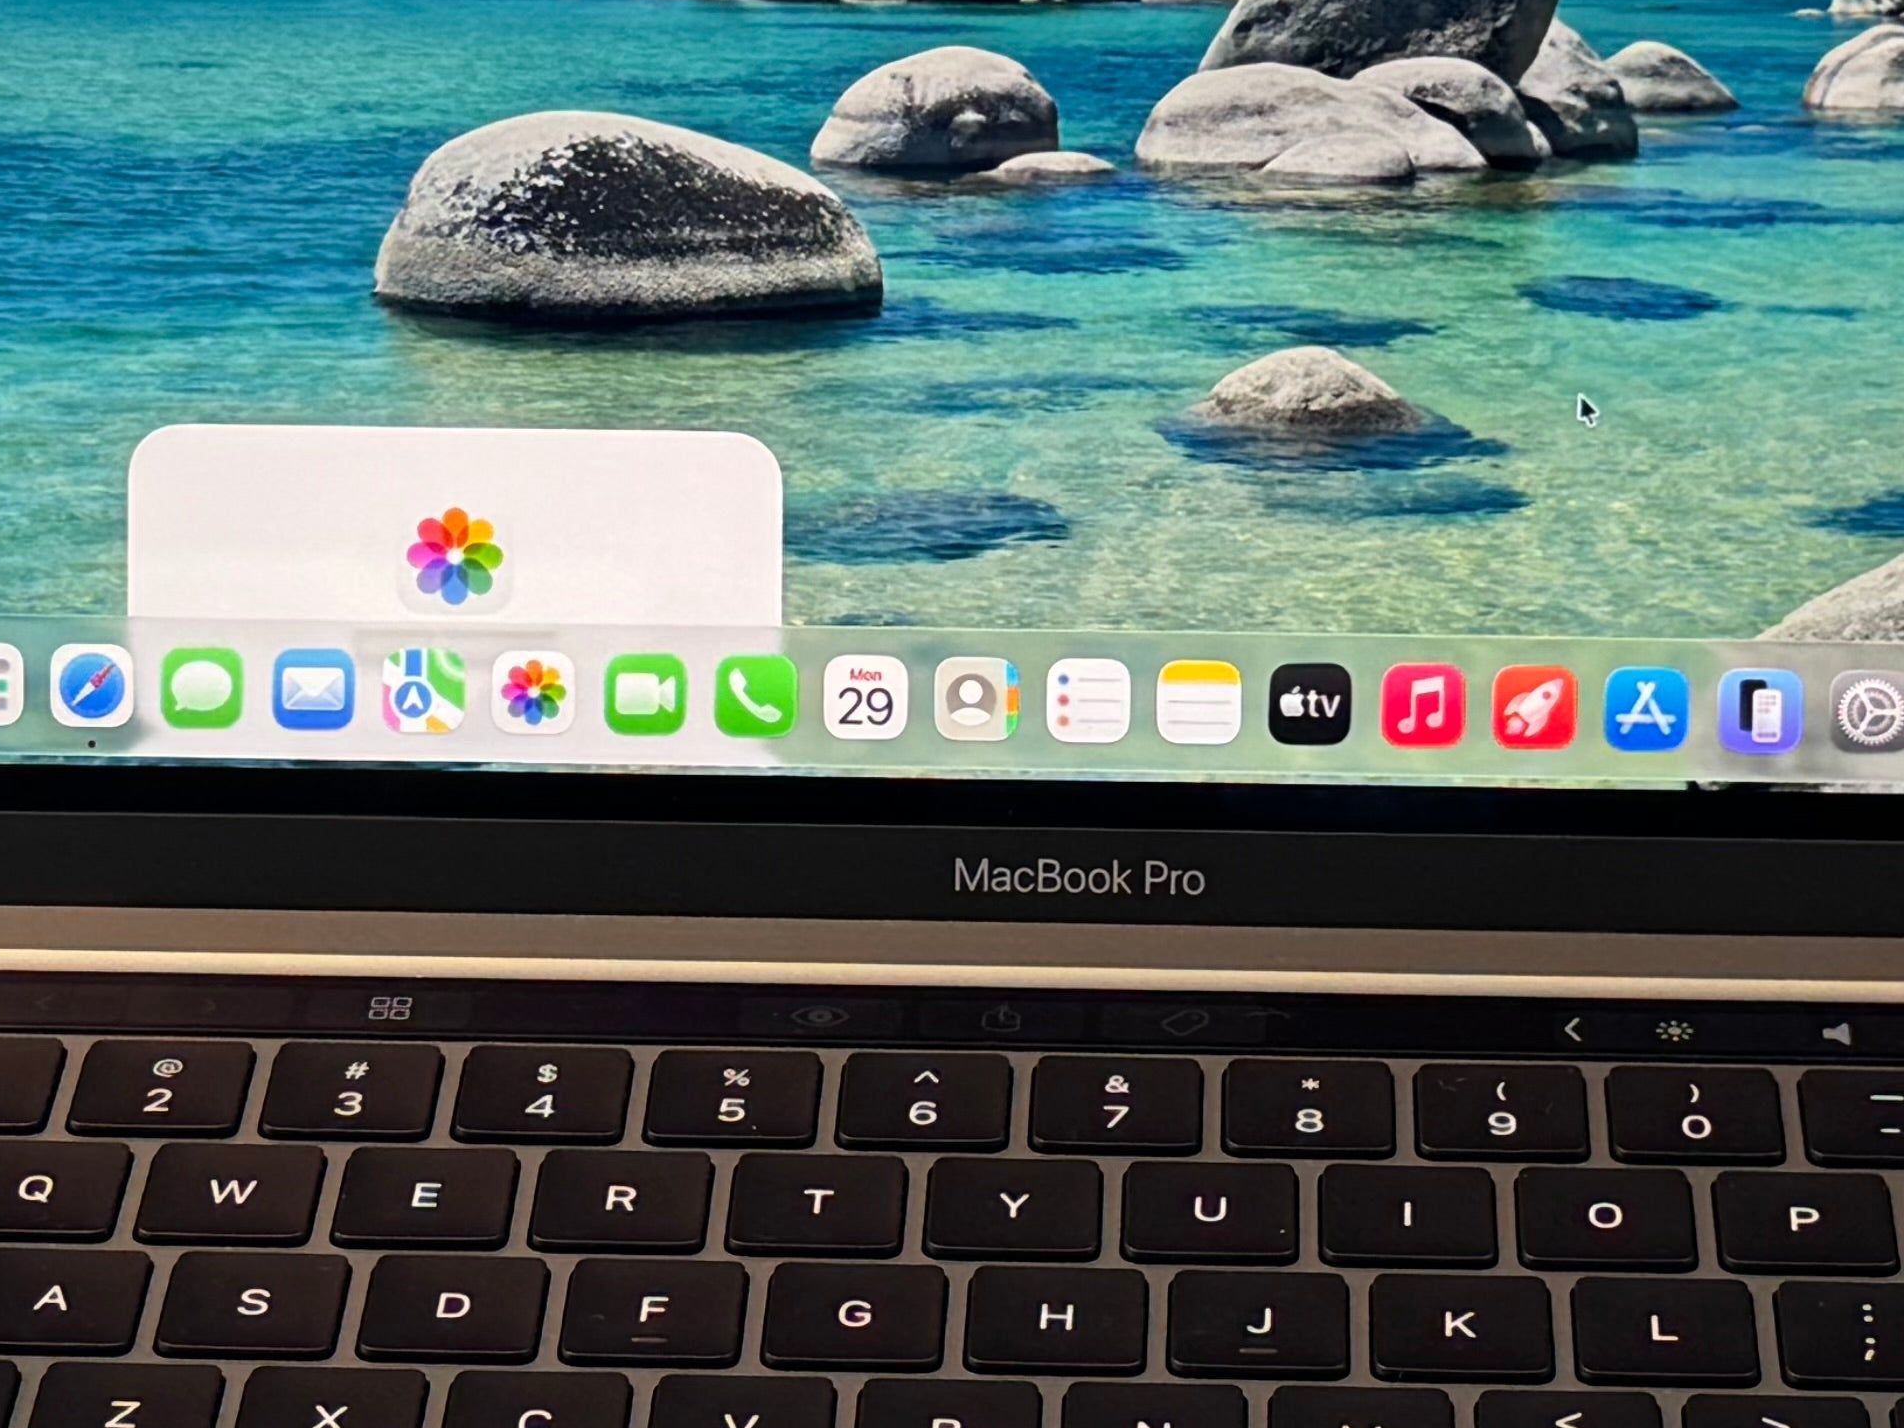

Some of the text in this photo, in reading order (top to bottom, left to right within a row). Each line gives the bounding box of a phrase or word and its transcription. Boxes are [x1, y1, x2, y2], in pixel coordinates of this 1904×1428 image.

[849, 666, 883, 683] Mon
[838, 686, 894, 726] 29
[1306, 691, 1341, 719] tv
[954, 857, 1206, 896] MacBook Pro
[152, 1058, 183, 1078] @
[345, 1061, 370, 1080] #
[537, 1063, 558, 1083] $
[723, 1068, 750, 1087] %
[1104, 1075, 1129, 1094] &
[143, 1088, 173, 1112] 2
[333, 1091, 363, 1116] 3
[524, 1094, 555, 1118] 4
[718, 1098, 746, 1122] 5
[908, 1101, 938, 1126] 6
[1103, 1105, 1130, 1129] 7
[1295, 1108, 1324, 1133] 8
[1487, 1111, 1517, 1136] 9
[18, 1174, 54, 1203] Q
[210, 1179, 258, 1205] W
[411, 1182, 442, 1208] E
[605, 1185, 637, 1212] R
[803, 1188, 835, 1215] T
[999, 1192, 1030, 1219] Y
[1194, 1196, 1227, 1222] U
[1403, 1201, 1412, 1227] I
[1588, 1202, 1623, 1229] O
[1789, 1206, 1820, 1232] P
[33, 1284, 67, 1311] A
[237, 1288, 271, 1316] S
[436, 1292, 471, 1319] D
[639, 1296, 669, 1323] F
[838, 1300, 872, 1327] G
[1039, 1303, 1074, 1331] H
[1246, 1307, 1272, 1334] J
[1444, 1311, 1477, 1338] K
[1650, 1314, 1679, 1341] L
[104, 1400, 141, 1428] Z
